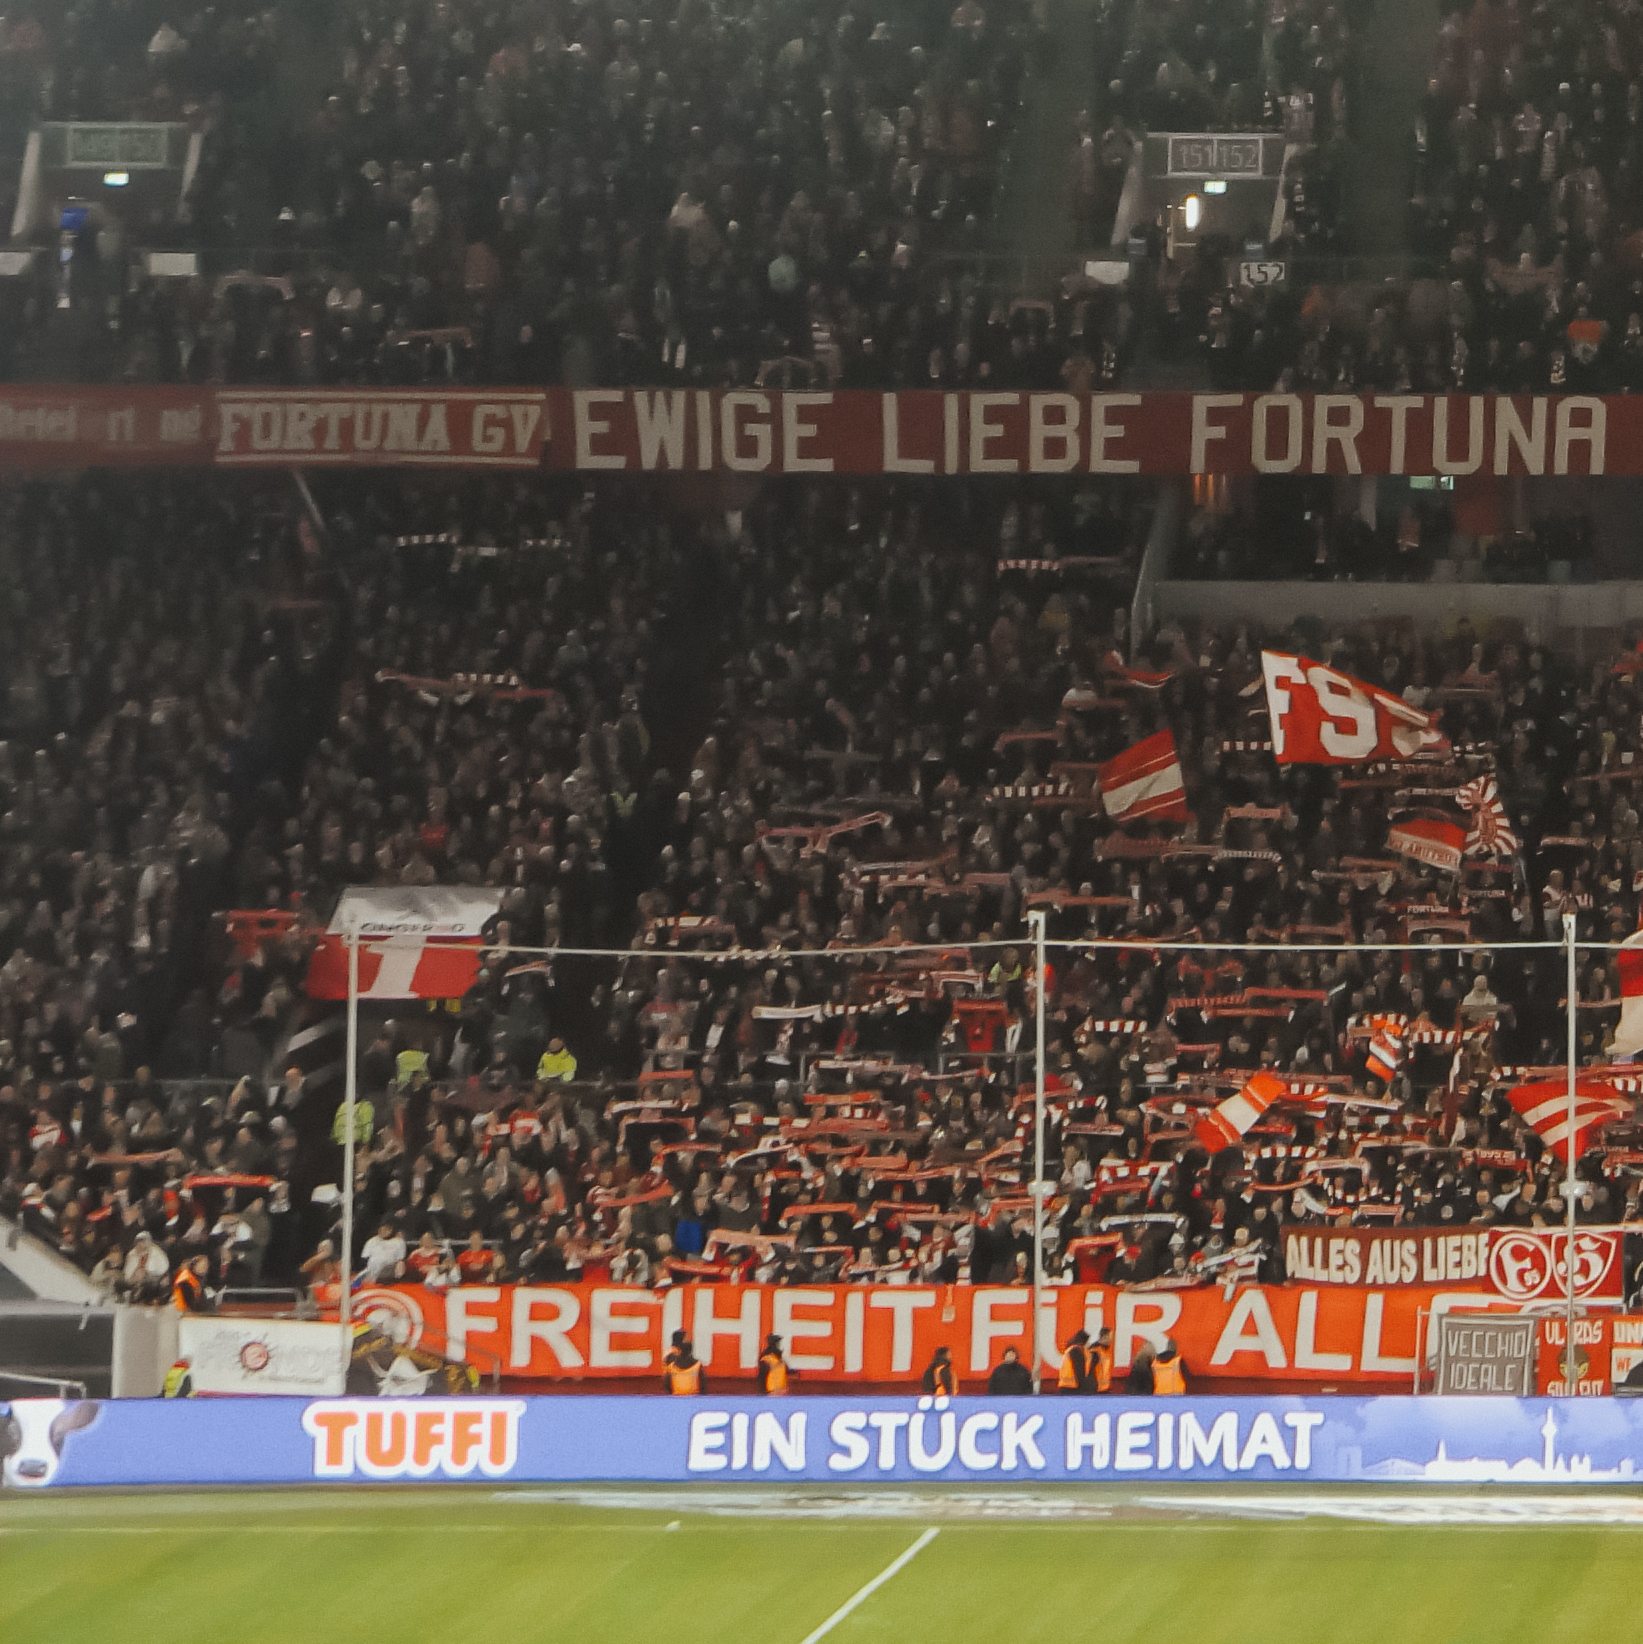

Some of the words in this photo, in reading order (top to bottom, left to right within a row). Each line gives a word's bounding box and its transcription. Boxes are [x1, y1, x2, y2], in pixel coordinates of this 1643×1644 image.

[217, 402, 451, 453] FORTUNA
[471, 402, 542, 454] GV
[573, 390, 835, 472] EWIGE
[881, 393, 1142, 474] LIEBE
[1189, 394, 1606, 476] FORTUNA
[1285, 1233, 1361, 1285] ALLES
[1365, 1238, 1418, 1285] AUS
[446, 1287, 936, 1372] FREIHEIT
[971, 1289, 1182, 1372] FÜR
[1447, 1329, 1529, 1358] VECCHIO
[1449, 1360, 1518, 1392] IDEALE
[307, 1406, 518, 1473] TUFFI
[688, 1412, 806, 1472] EIN
[828, 1395, 1046, 1472] STÜCK
[1065, 1411, 1324, 1472] HEIMAT
